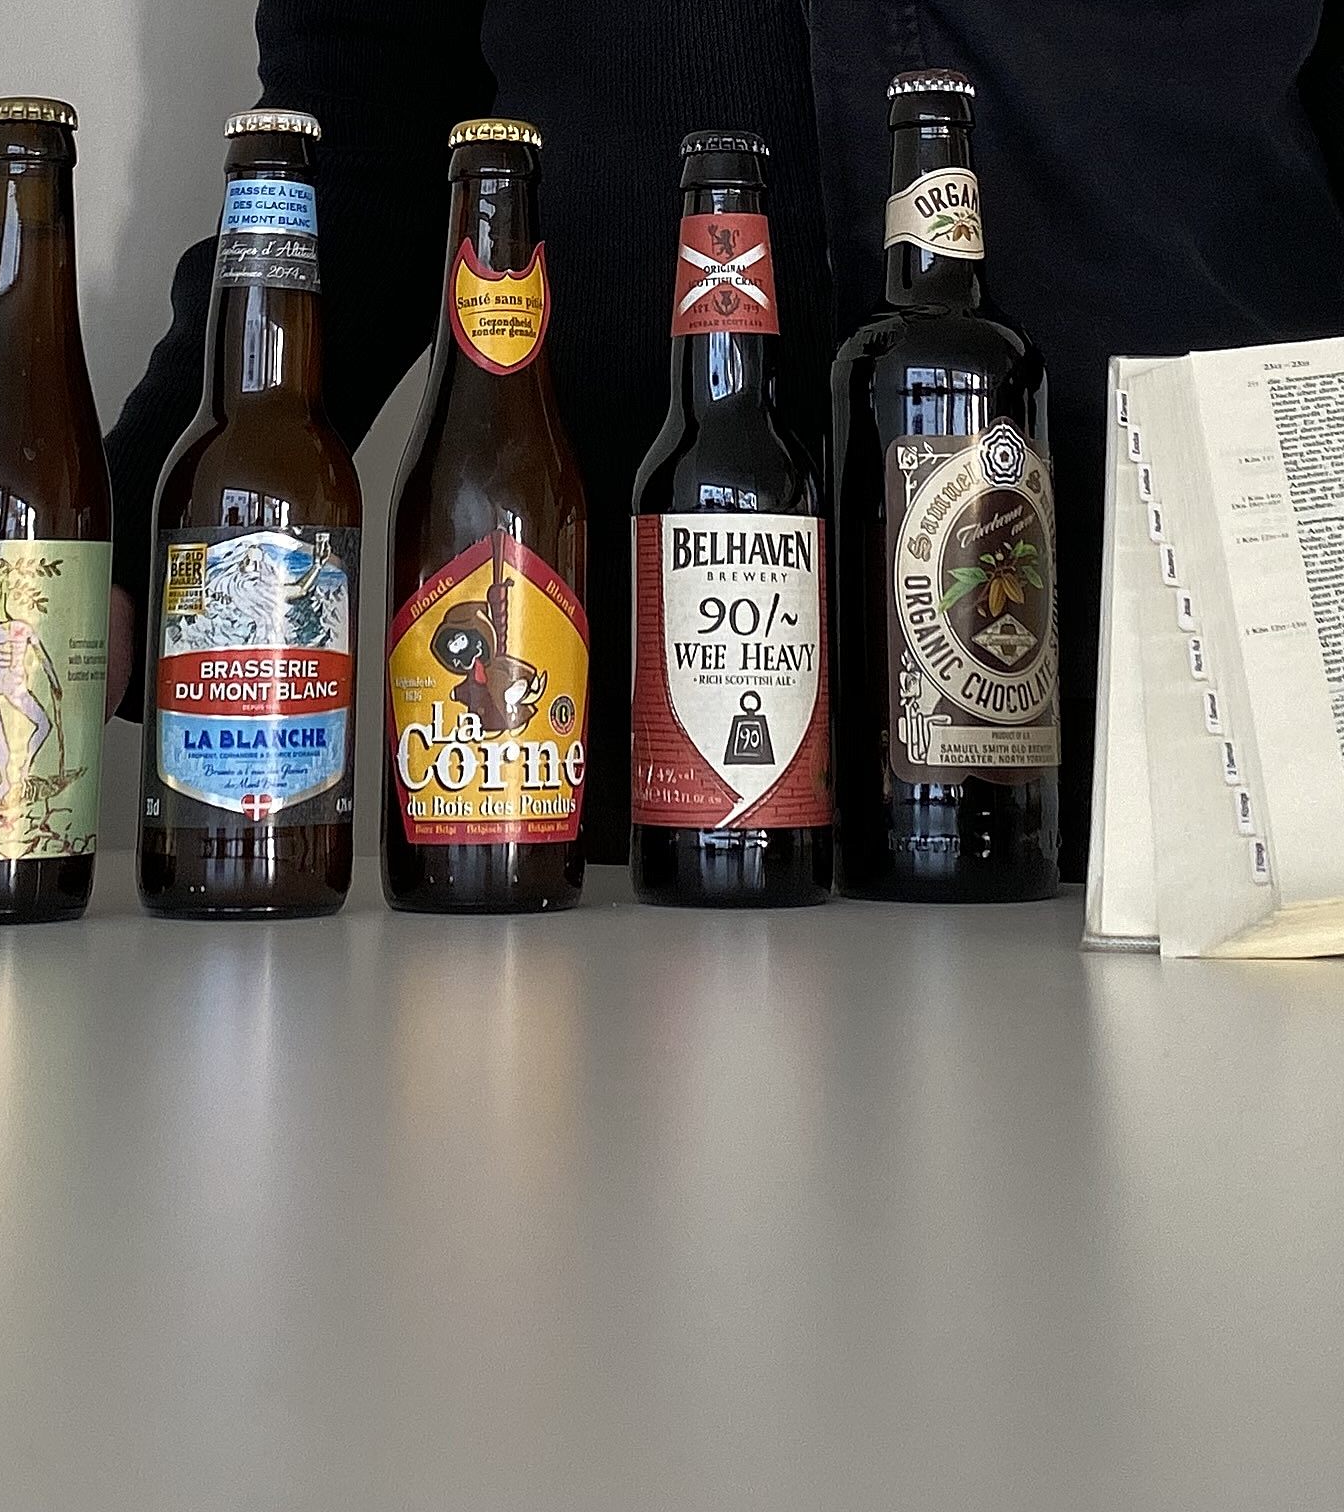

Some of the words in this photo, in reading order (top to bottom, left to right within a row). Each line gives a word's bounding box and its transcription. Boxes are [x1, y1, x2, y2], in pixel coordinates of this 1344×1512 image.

[233, 201, 252, 209] DES
[255, 201, 308, 213] GLACIERS
[228, 215, 238, 225] DU
[242, 215, 275, 224] MONT
[278, 217, 311, 228] BLANC
[457, 293, 490, 309] Santé
[495, 295, 522, 305] sans
[472, 327, 506, 337] zonder
[672, 527, 812, 572] BELHAVEN
[171, 562, 202, 578] BEER
[707, 572, 789, 582] BREWERY
[409, 575, 455, 619] Blonde
[545, 580, 576, 618] Blond
[904, 574, 964, 681] ORGANIC
[674, 643, 726, 670] WEE
[739, 642, 815, 672] HEAVY
[200, 660, 319, 679] BRASSERIE
[699, 675, 722, 684] RICH
[725, 675, 772, 686] SCOTTISH
[775, 676, 791, 686] ALE
[175, 684, 203, 700] DU
[210, 682, 272, 701] MONT
[276, 681, 338, 700] BLANC
[431, 701, 485, 743] La
[184, 730, 212, 749] LA
[220, 728, 326, 749] BLANCHE
[740, 728, 760, 750] 90
[940, 744, 979, 753] SAMUEL
[982, 745, 1009, 753] SMITH
[396, 723, 585, 792] Corne
[407, 796, 426, 816] du
[432, 795, 473, 816] Bois
[480, 795, 513, 816] des
[521, 793, 576, 816] Pendus
